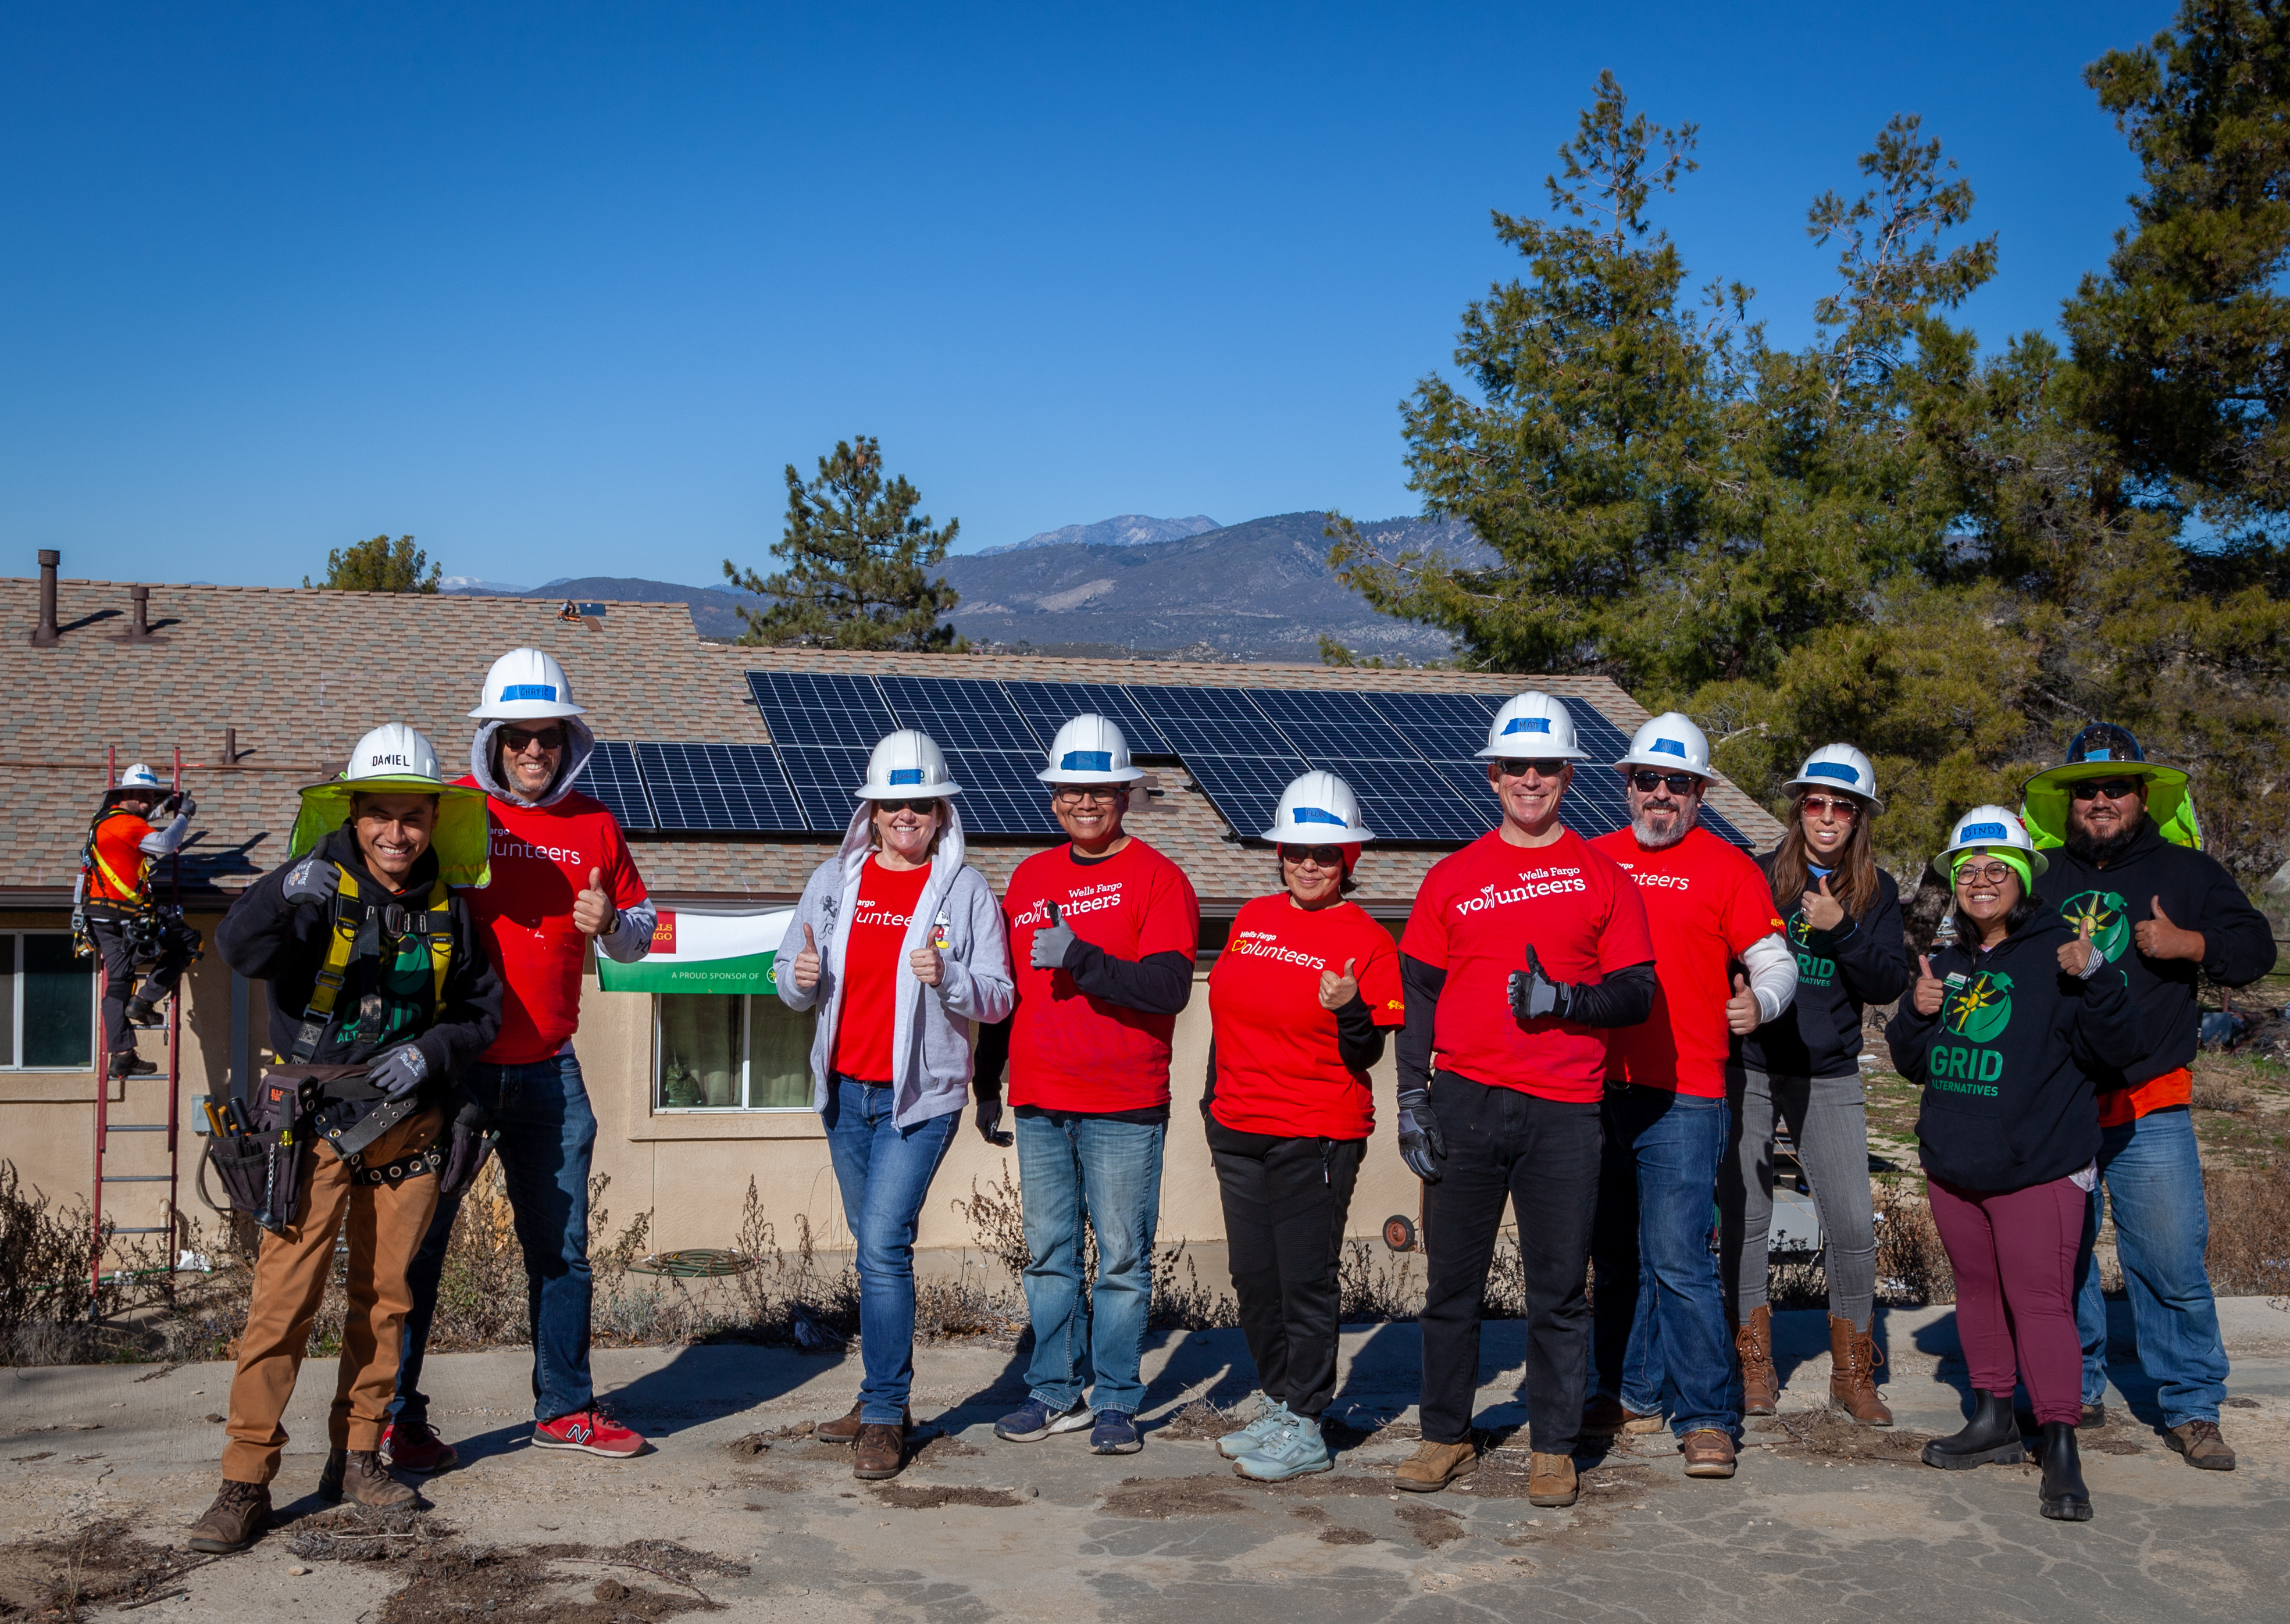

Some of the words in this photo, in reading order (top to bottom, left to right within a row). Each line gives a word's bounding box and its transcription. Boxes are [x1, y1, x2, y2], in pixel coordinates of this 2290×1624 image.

[1519, 721, 1542, 731] MATT
[1657, 741, 1679, 753] DAVID
[372, 754, 410, 766] DANIEL
[1822, 766, 1844, 775] NIKA
[1306, 809, 1328, 819] FLOR
[1964, 825, 2003, 837] CINDY
[489, 837, 581, 865] lunteers
[1518, 868, 1549, 881] Wells
[1550, 867, 1580, 876] Fargo
[1630, 872, 1689, 890] nteers
[1068, 886, 1094, 898] Wells
[1096, 882, 1122, 893] Fargo
[857, 900, 875, 908] argo
[1257, 932, 1276, 941] Fargo
[1789, 950, 1835, 977] RID
[1799, 976, 1831, 987] NATIVES
[1931, 1045, 2003, 1082] GRID
[1932, 1079, 1999, 1097] ALTERNATIVES
